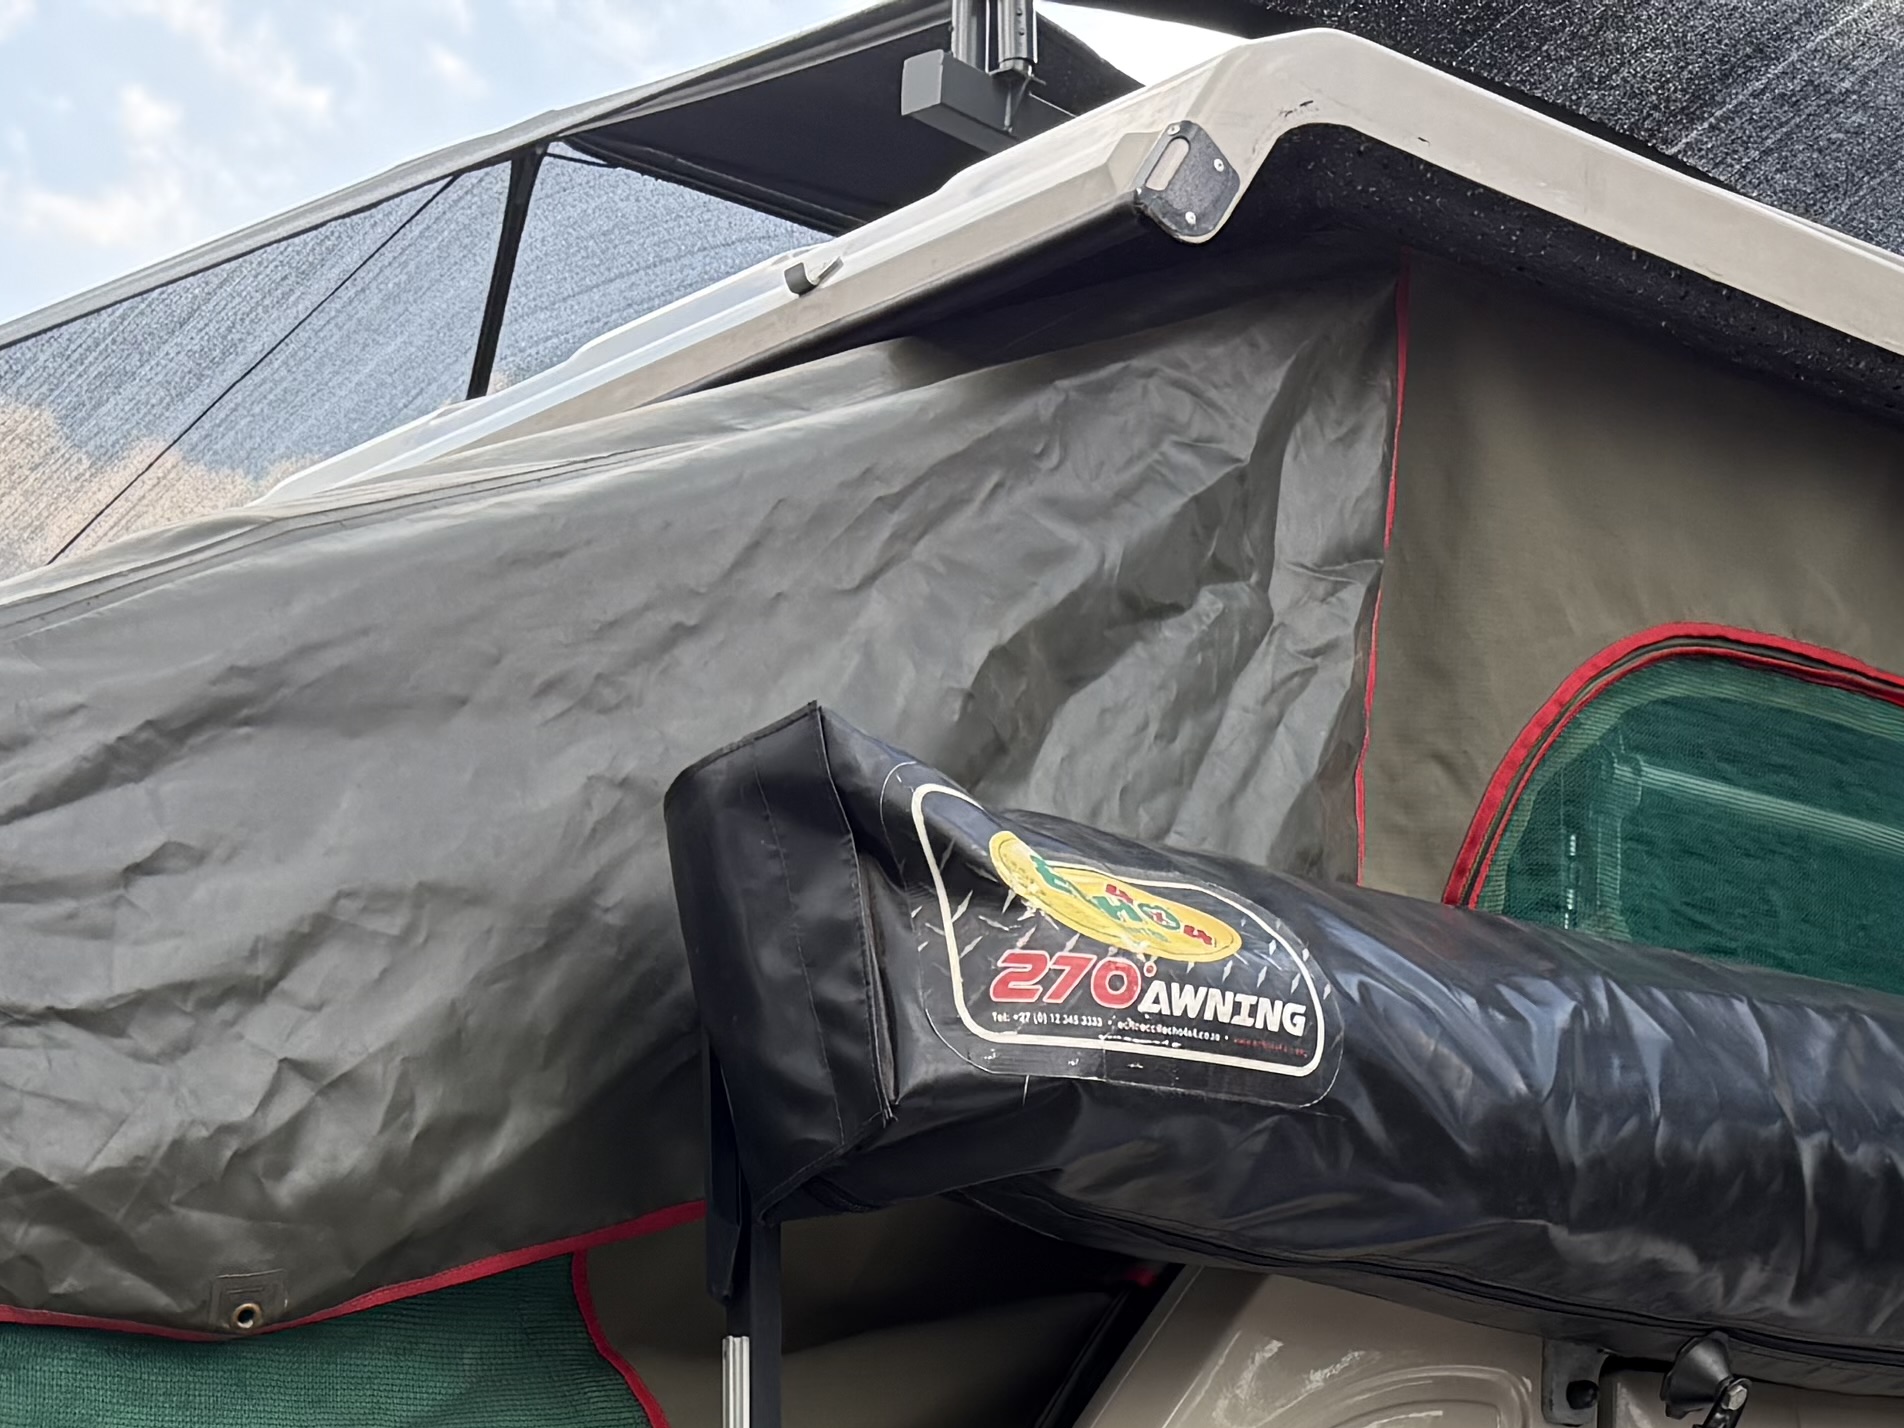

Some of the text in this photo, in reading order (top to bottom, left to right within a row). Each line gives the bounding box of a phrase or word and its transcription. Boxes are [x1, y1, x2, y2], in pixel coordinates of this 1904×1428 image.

[1033, 1012, 1047, 1025] (0)
[1050, 1013, 1061, 1024] 12
[1062, 1014, 1079, 1025] 345
[1137, 980, 1306, 1036] AWNING
